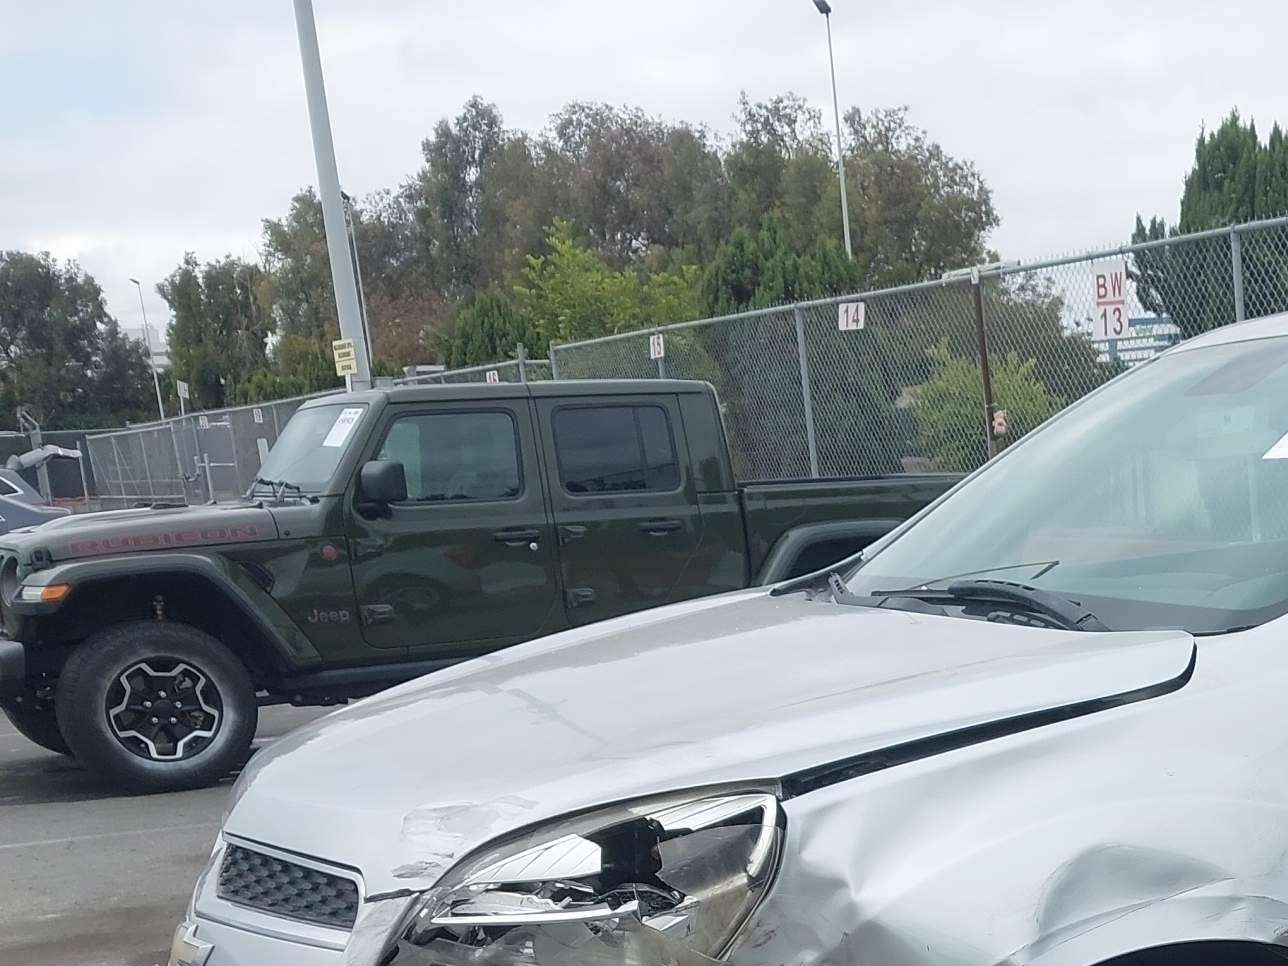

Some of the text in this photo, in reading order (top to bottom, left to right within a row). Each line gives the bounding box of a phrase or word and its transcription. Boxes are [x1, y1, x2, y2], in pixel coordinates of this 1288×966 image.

[1096, 272, 1122, 299] BW
[843, 303, 860, 329] 14
[1100, 307, 1124, 336] 13
[65, 527, 257, 553] RUBICON
[307, 609, 350, 624] Jeep
